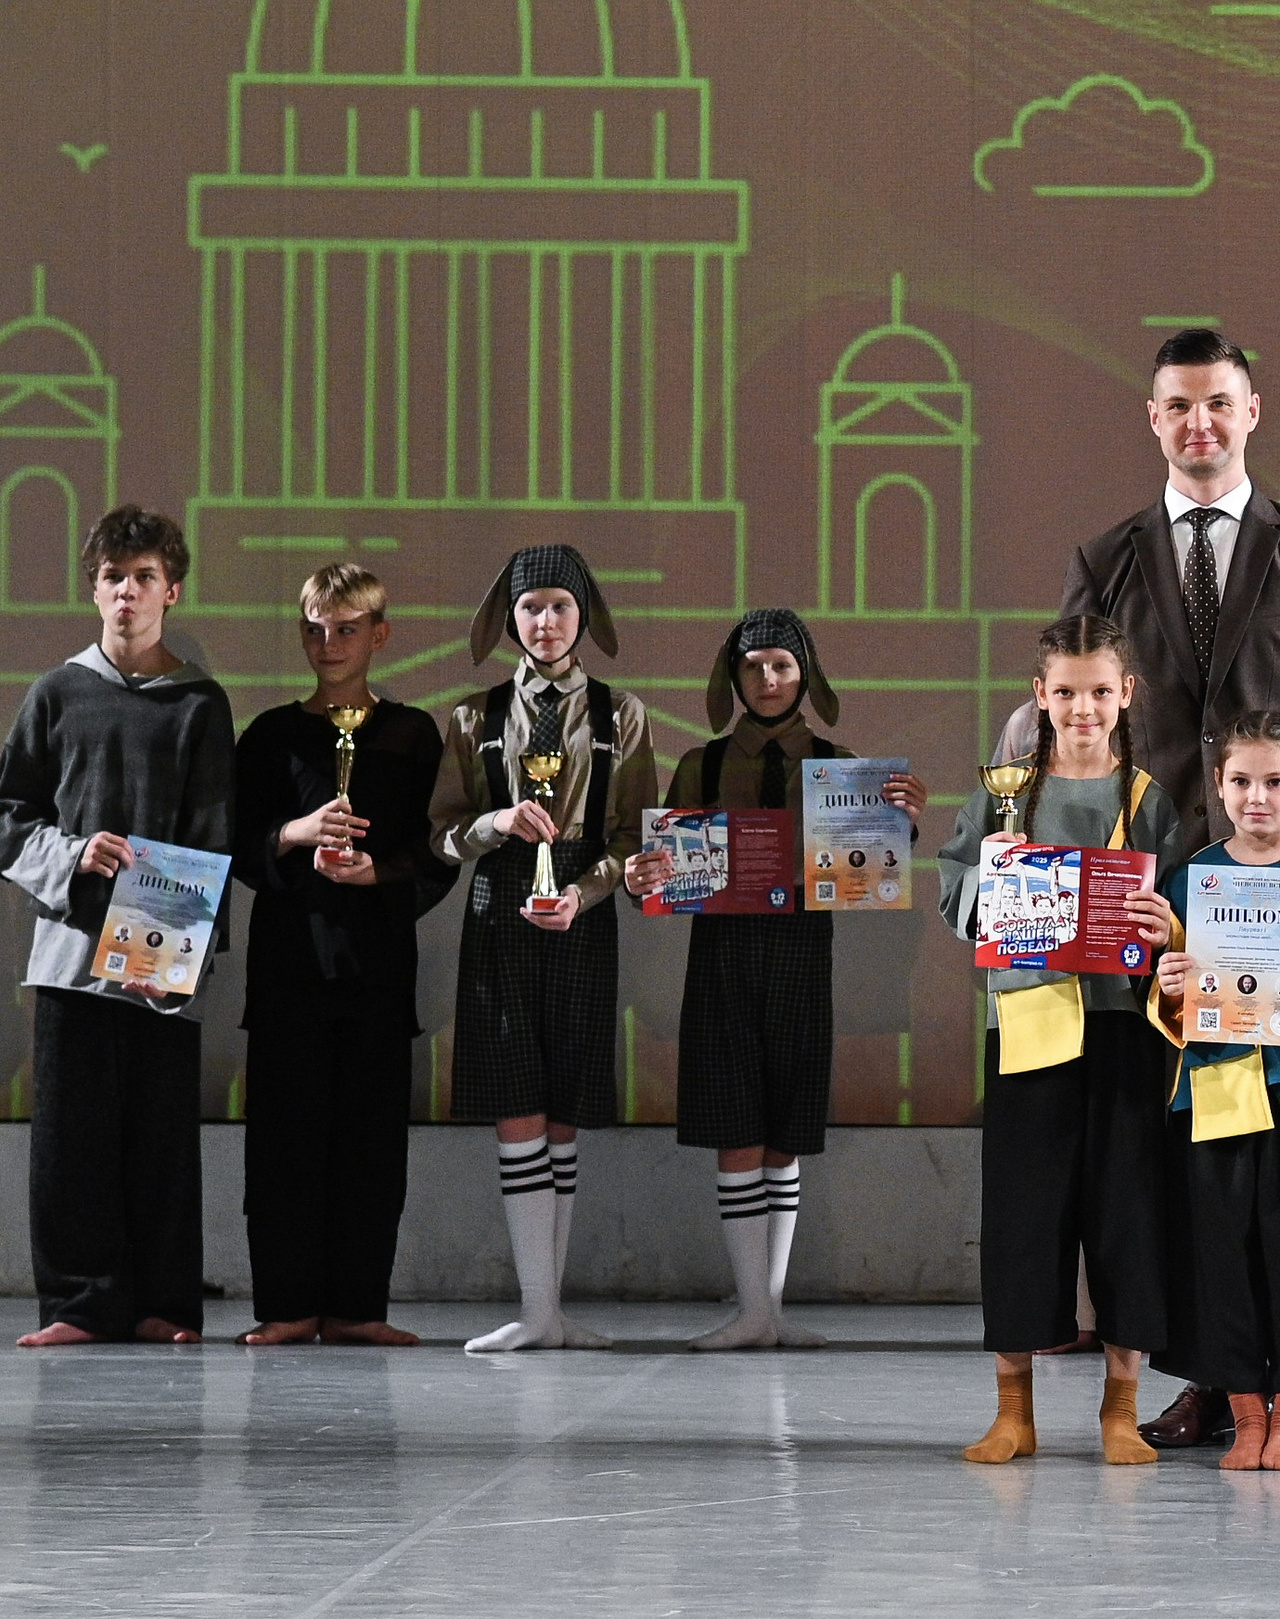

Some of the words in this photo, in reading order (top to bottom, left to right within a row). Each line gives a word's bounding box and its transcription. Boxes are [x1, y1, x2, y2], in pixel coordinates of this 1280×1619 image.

[1031, 856, 1048, 864] 2025
[132, 873, 205, 897] ДИПЛОМ
[660, 887, 714, 904] ПОБЕДЫ
[993, 915, 1066, 933] ФОРМУЛА
[1002, 926, 1056, 943] НАШЕЙ
[996, 938, 1059, 956] ПОБЕДЫ
